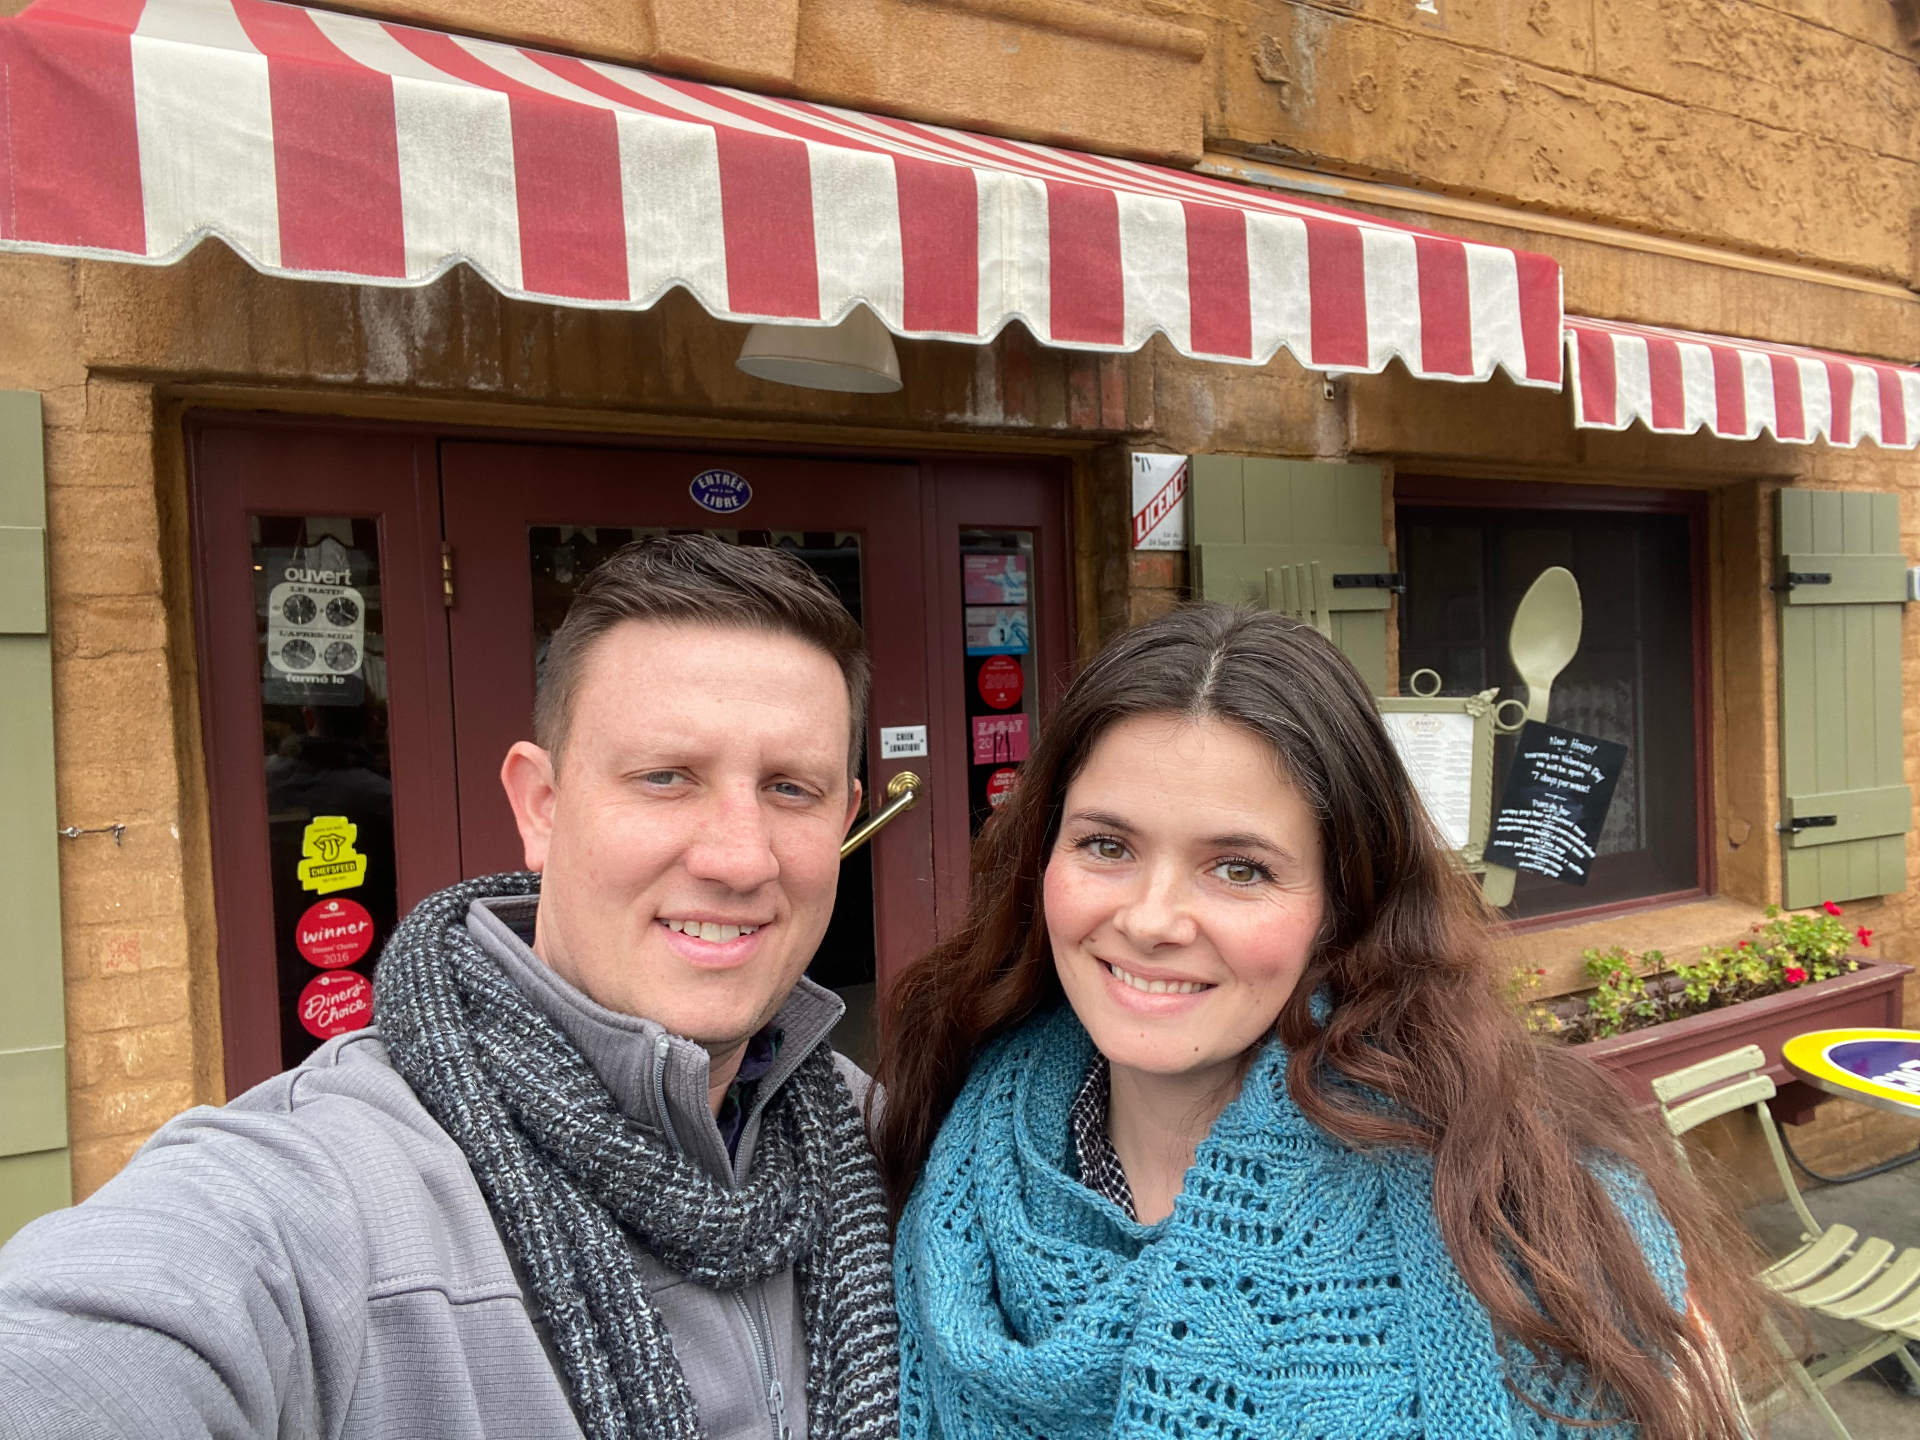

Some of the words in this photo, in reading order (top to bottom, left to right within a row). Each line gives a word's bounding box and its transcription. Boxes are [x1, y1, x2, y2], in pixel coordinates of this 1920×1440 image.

[702, 493, 740, 509] LIBRE
[1136, 463, 1188, 542] LICENCE
[284, 567, 352, 586] ouvert
[290, 585, 305, 594] LE
[308, 587, 345, 596] MATIN
[286, 673, 329, 684] fermé
[332, 674, 345, 684] le
[978, 719, 1023, 736] ZAGAT
[1549, 736, 1567, 747] New
[1531, 770, 1540, 781] 7
[1540, 773, 1557, 787] days
[310, 862, 356, 877] CHEFSFEED
[302, 920, 369, 945] winner
[337, 941, 359, 951] Choice
[323, 952, 350, 965] 2016
[317, 998, 367, 1028] Choice
